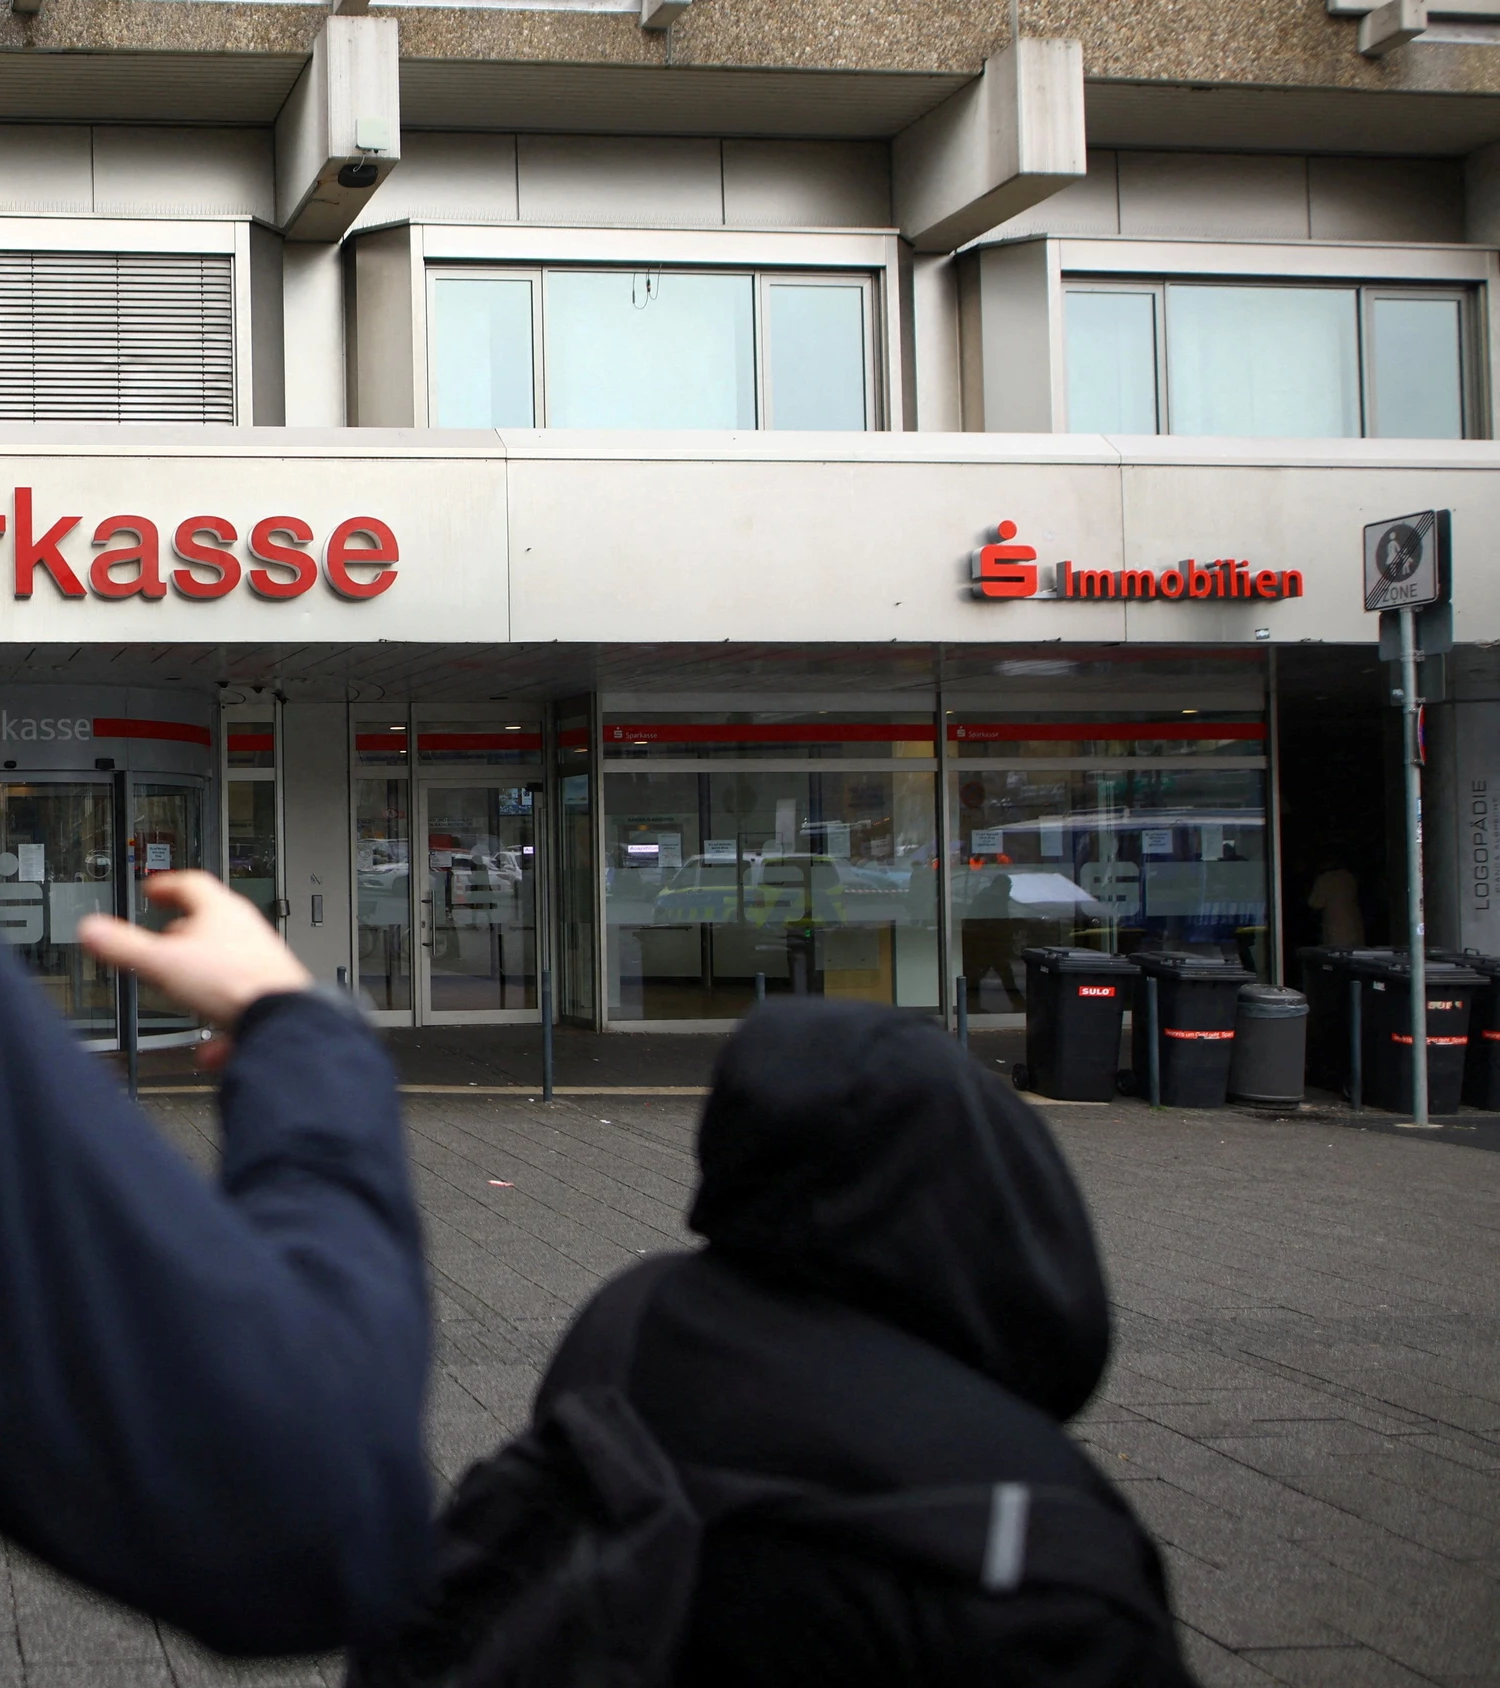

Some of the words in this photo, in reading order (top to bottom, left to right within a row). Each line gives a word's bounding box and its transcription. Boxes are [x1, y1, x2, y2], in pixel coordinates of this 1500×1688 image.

[1060, 559, 1303, 599] Immobilien
[1382, 583, 1418, 603] ZONE
[626, 731, 657, 740] Sparkasse
[968, 731, 999, 739] Sparkasse
[1470, 780, 1490, 910] LOGOPÄDIE
